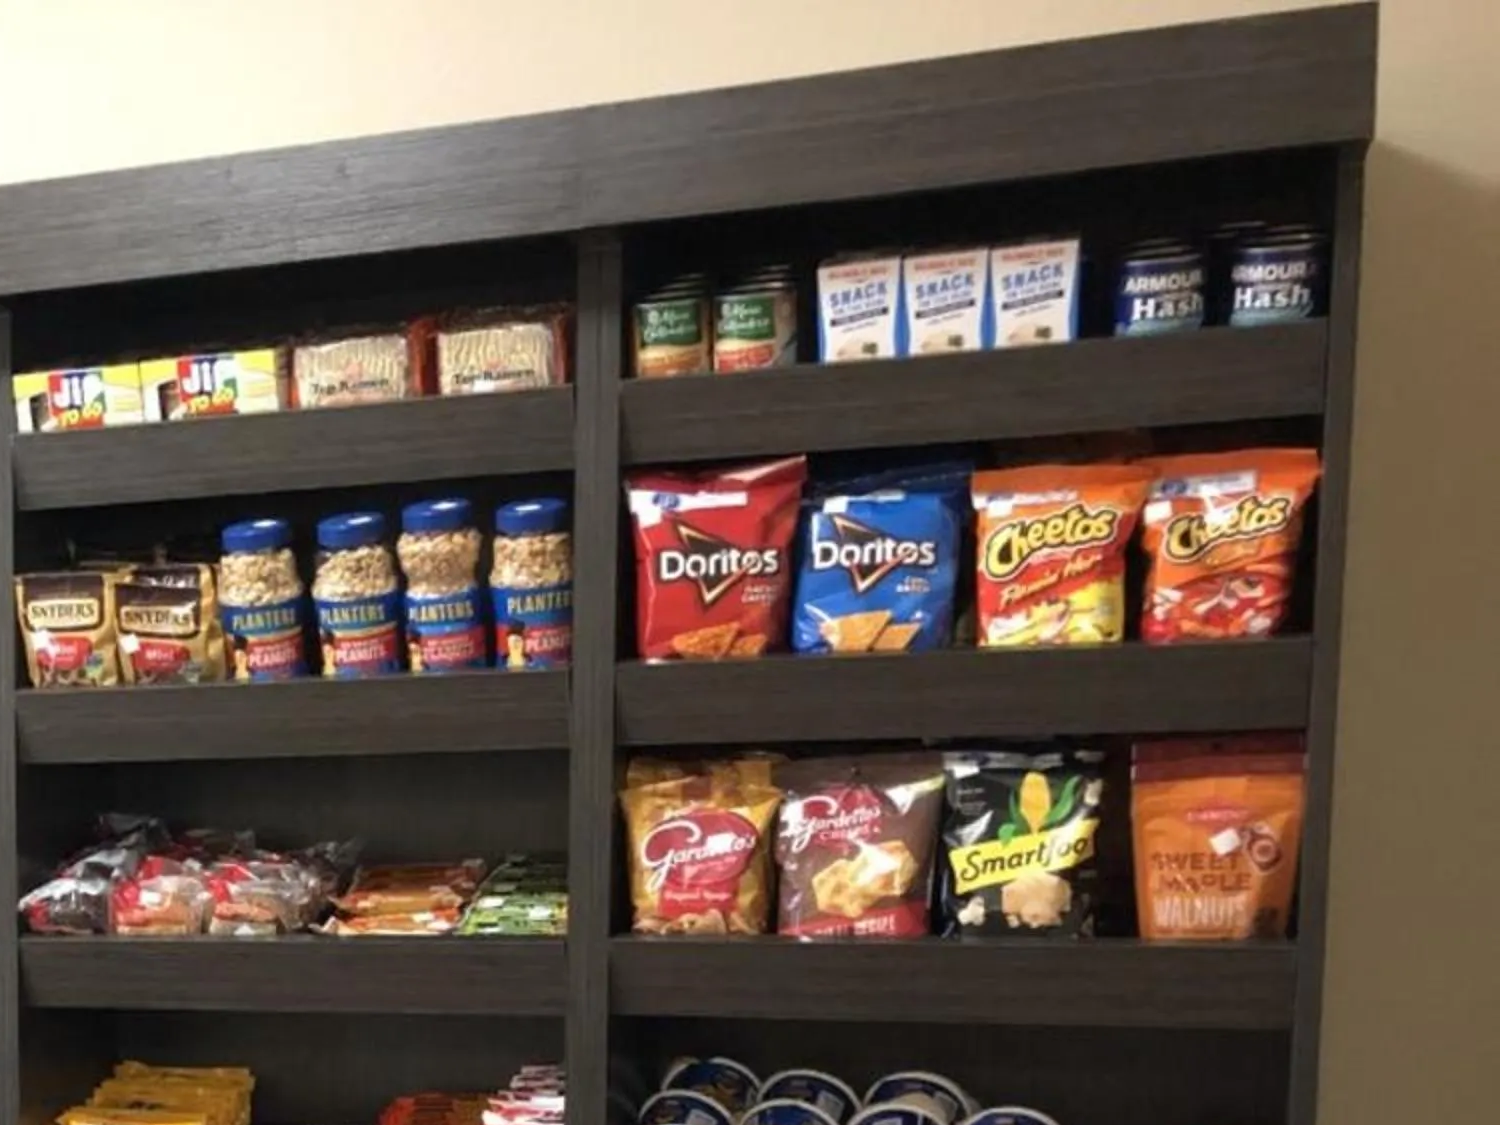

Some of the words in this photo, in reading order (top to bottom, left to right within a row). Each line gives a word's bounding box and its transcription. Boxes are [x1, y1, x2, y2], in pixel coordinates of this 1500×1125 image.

[915, 272, 976, 300] SNACK
[1002, 262, 1065, 292] SNACK
[830, 281, 888, 308] SNACK
[1131, 293, 1203, 321] Hash
[1233, 285, 1312, 309] Hash
[985, 503, 1120, 579] Cheetos
[1164, 496, 1292, 562] Chetos
[659, 549, 779, 582] Doritos
[814, 537, 936, 570] Doritos
[232, 608, 296, 632] PLANTERS
[320, 603, 385, 625] PLANTERS
[409, 600, 474, 623] PLANTERS
[1152, 852, 1239, 872] SWEET
[1155, 872, 1251, 893] MAPLE
[1154, 896, 1250, 929] WALNUTS
